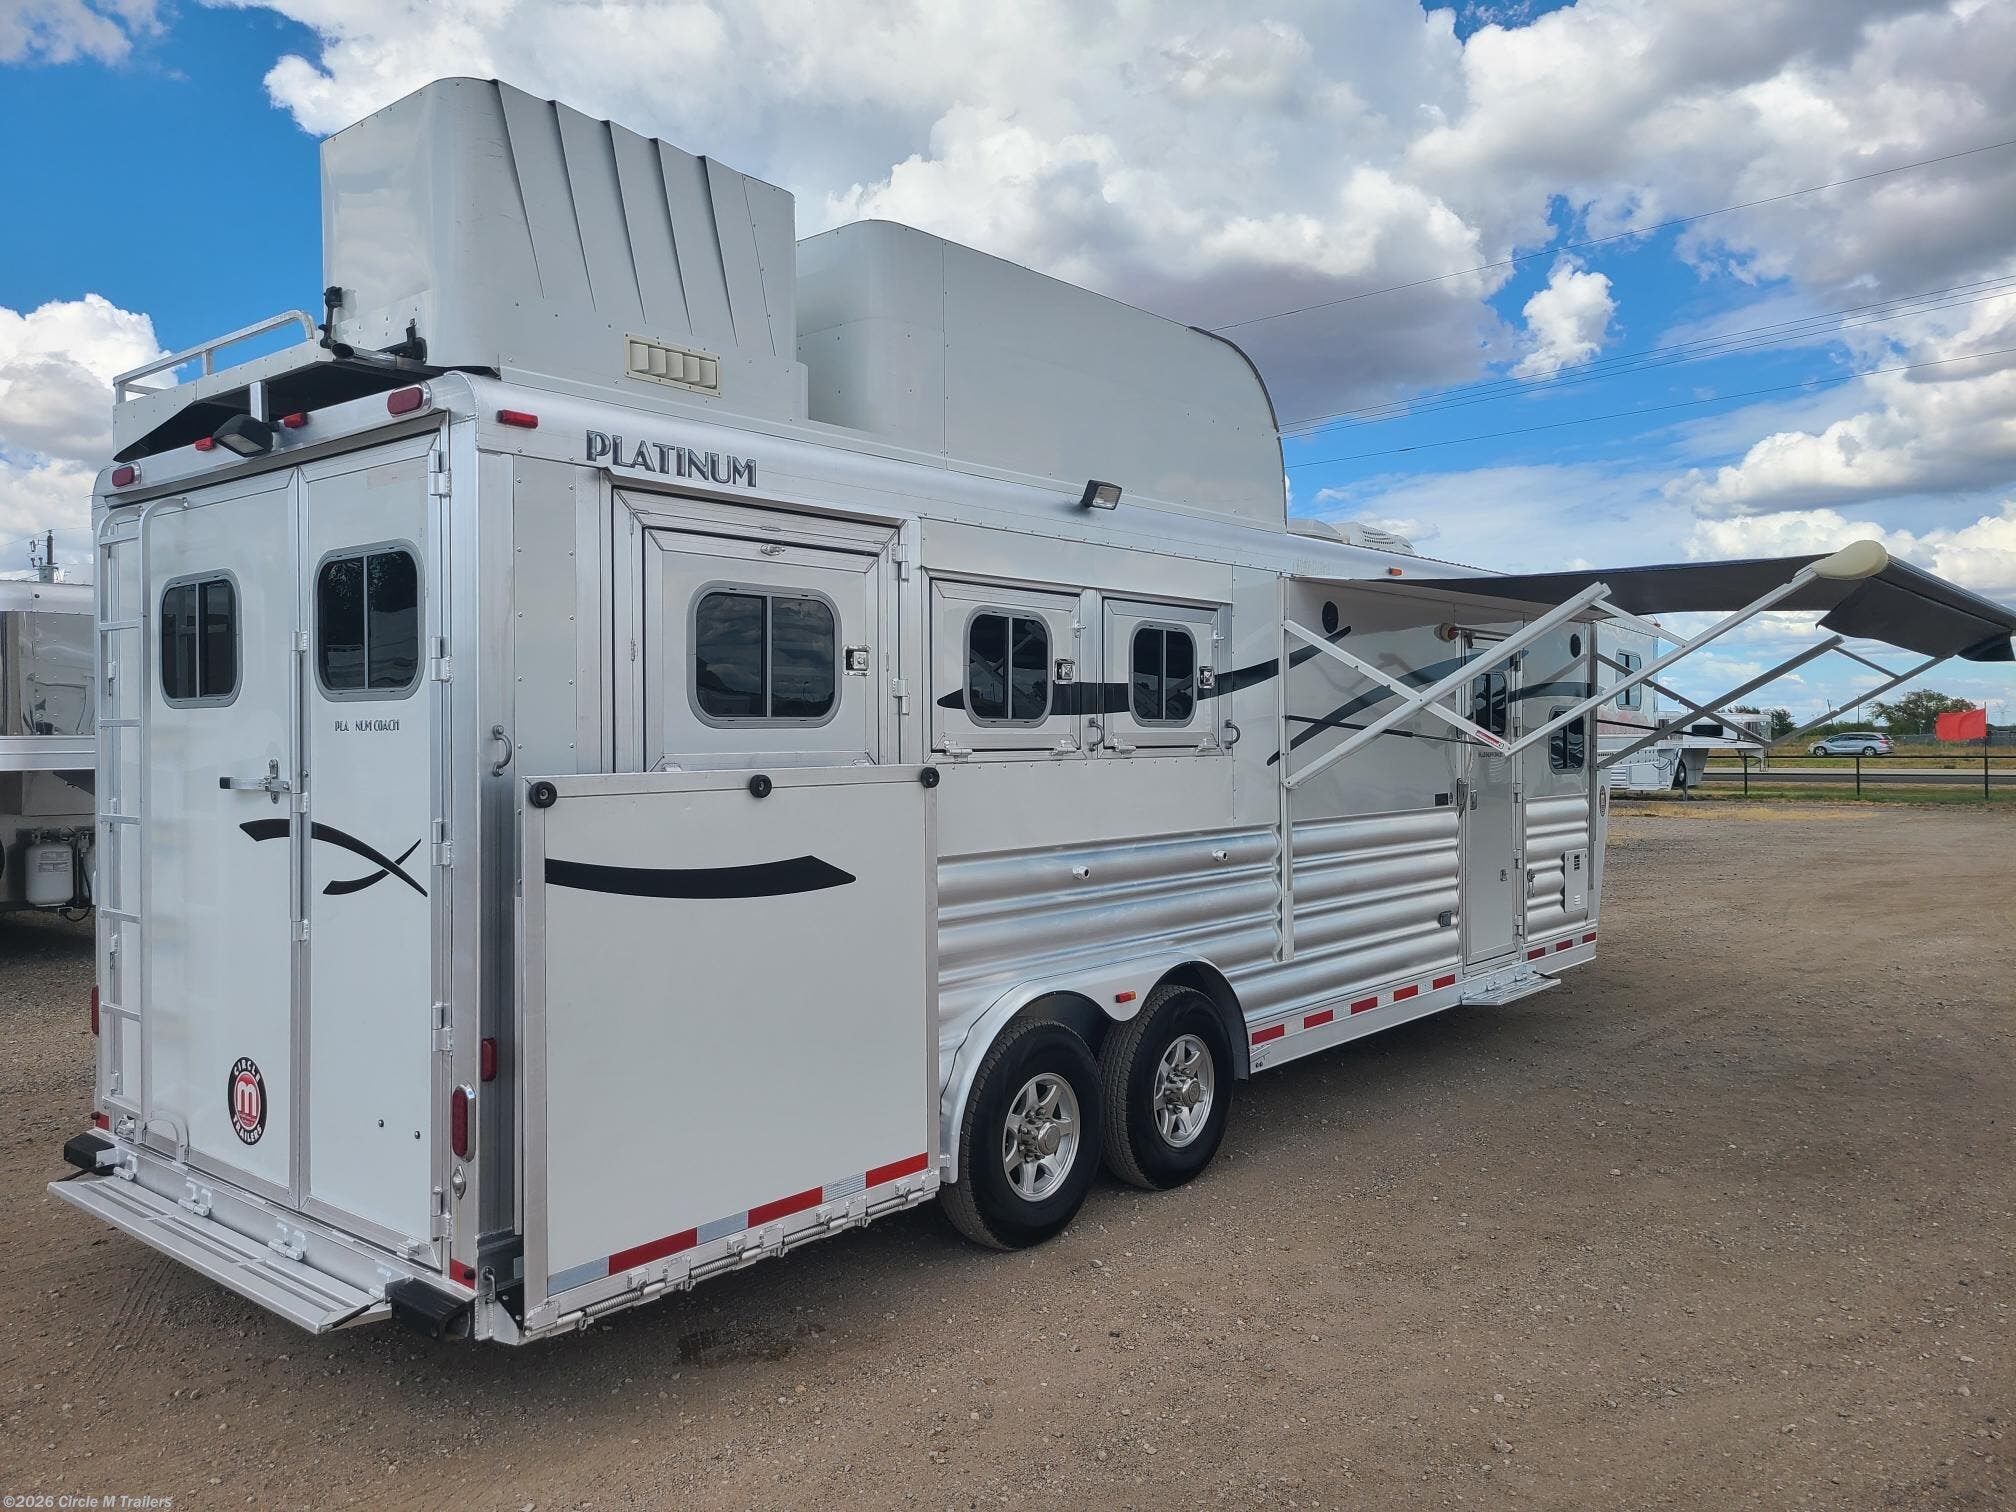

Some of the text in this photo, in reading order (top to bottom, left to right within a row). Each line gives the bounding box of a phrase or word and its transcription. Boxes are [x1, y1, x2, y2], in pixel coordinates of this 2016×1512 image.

[586, 429, 757, 488] PLATINUM
[373, 719, 400, 732] COACH
[233, 1059, 261, 1083] CIRCLE
[233, 1113, 263, 1143] TRAILERS
